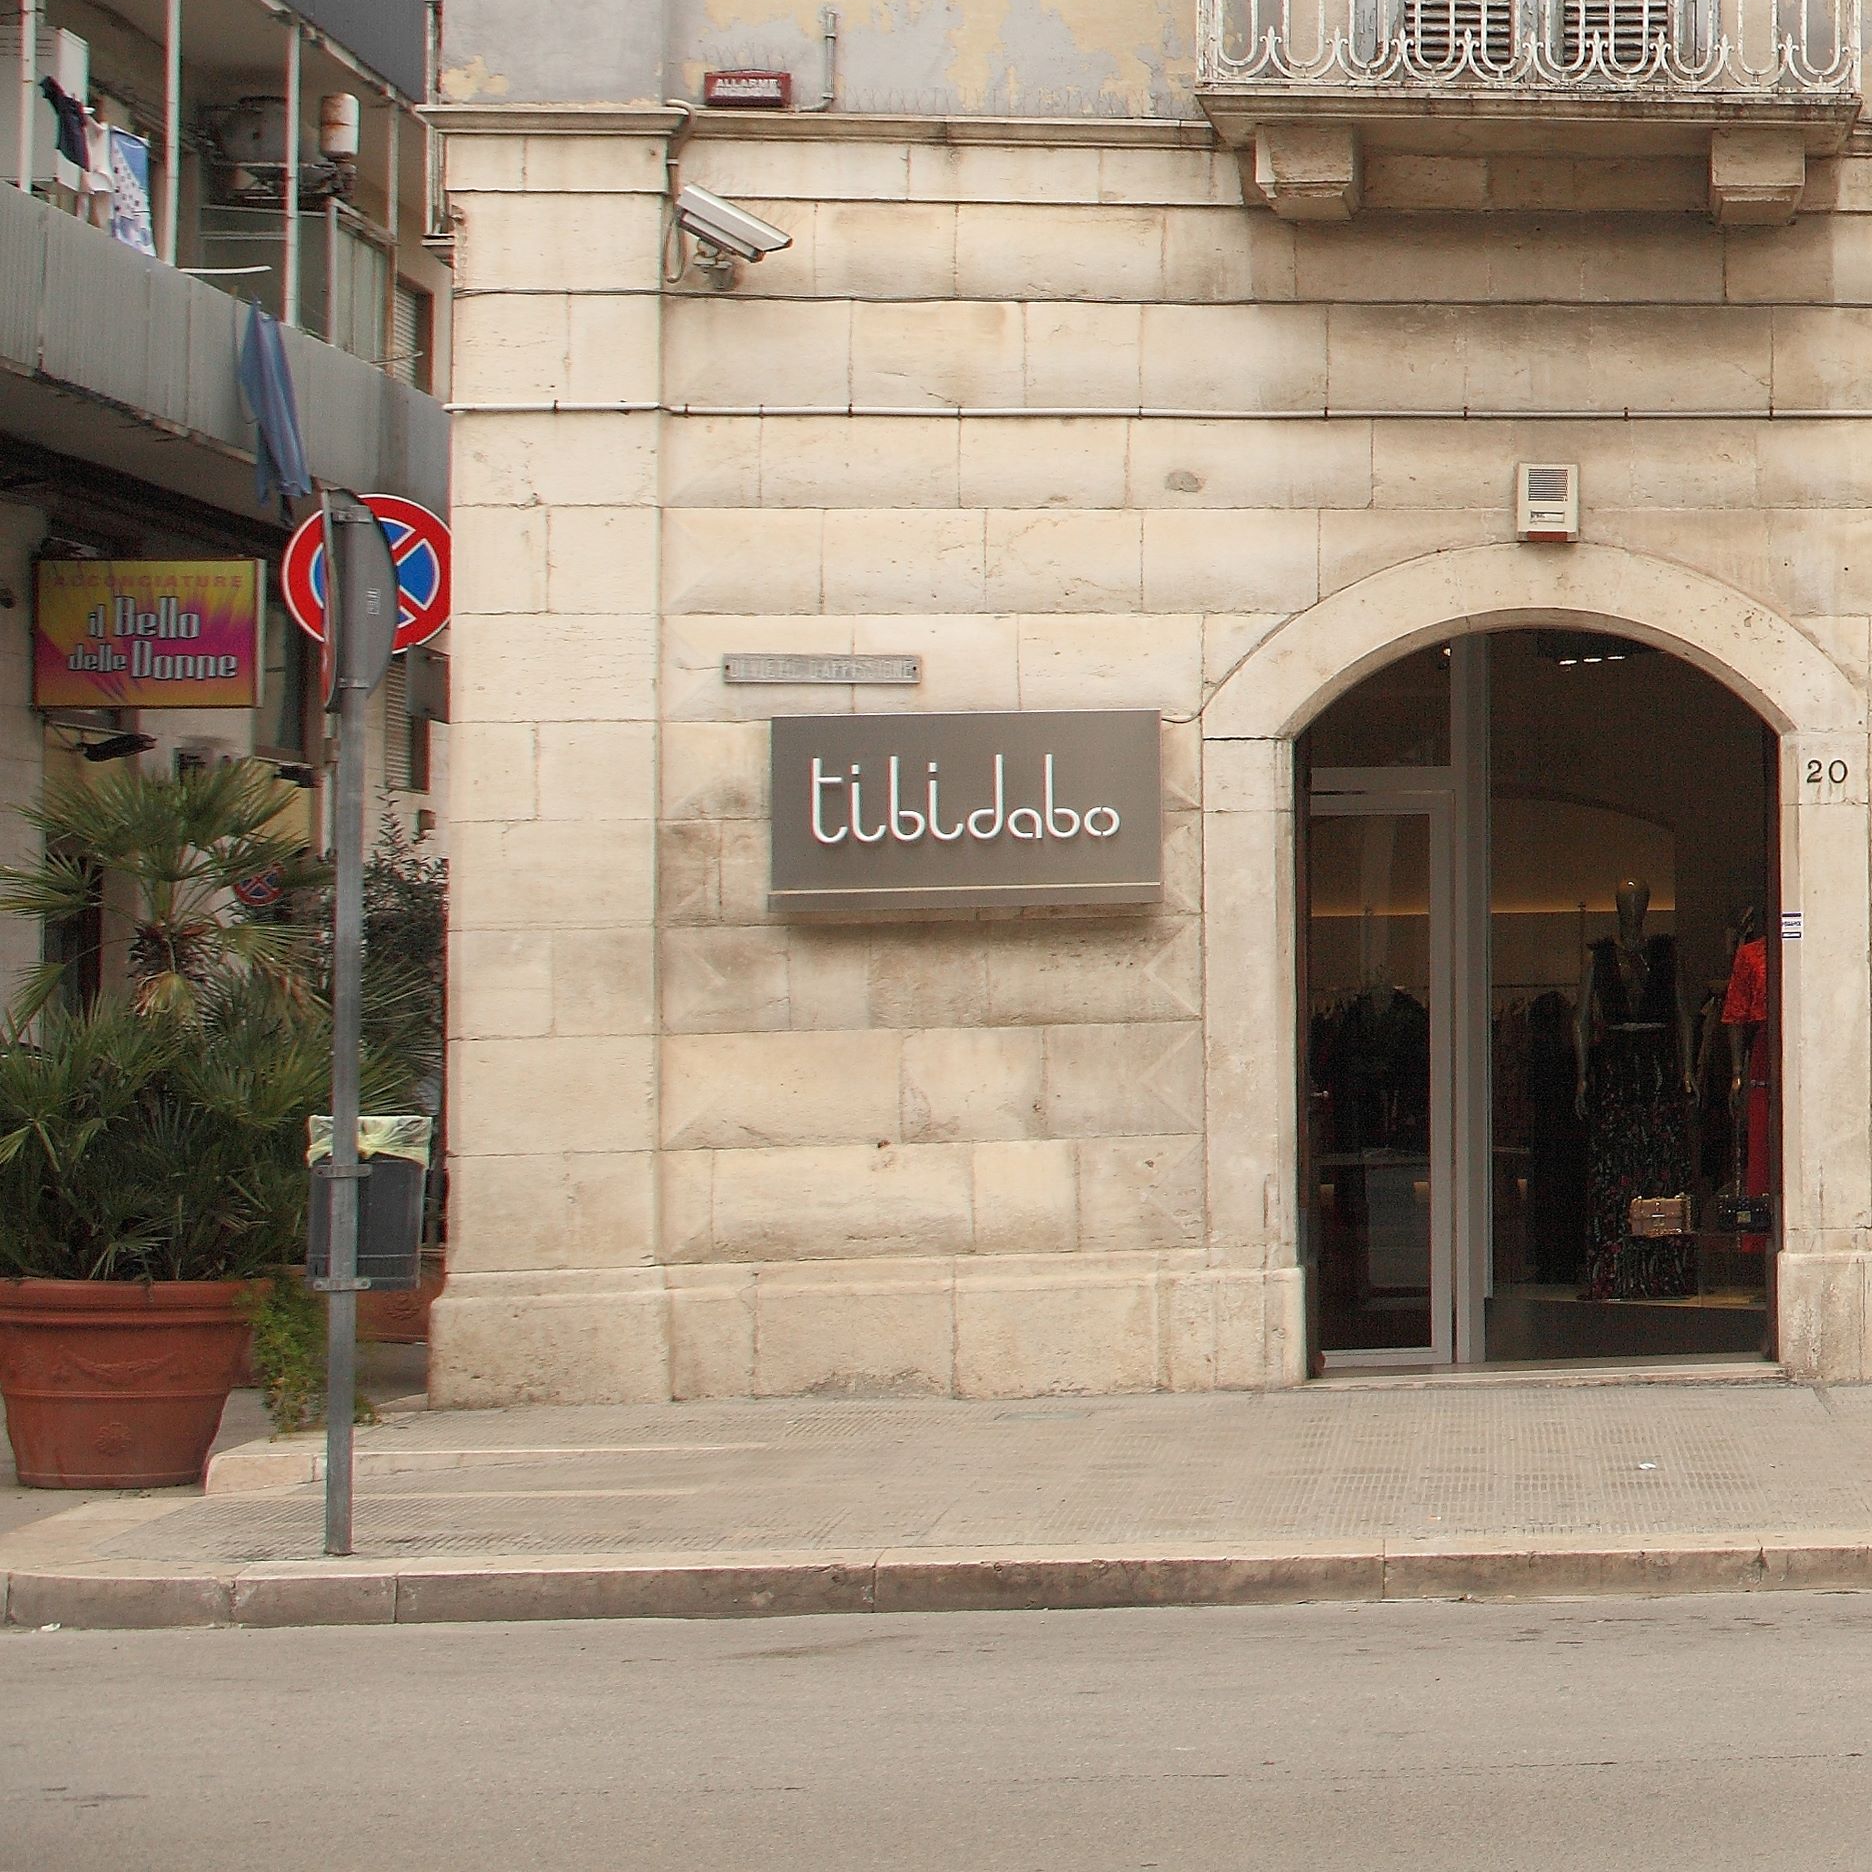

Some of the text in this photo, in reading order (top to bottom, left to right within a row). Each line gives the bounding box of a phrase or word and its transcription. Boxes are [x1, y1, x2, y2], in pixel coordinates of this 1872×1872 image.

[88, 595, 200, 639] il Bello
[67, 639, 239, 681] delle Donne
[1806, 759, 1849, 784] 20
[811, 753, 1121, 844] tibidabo
